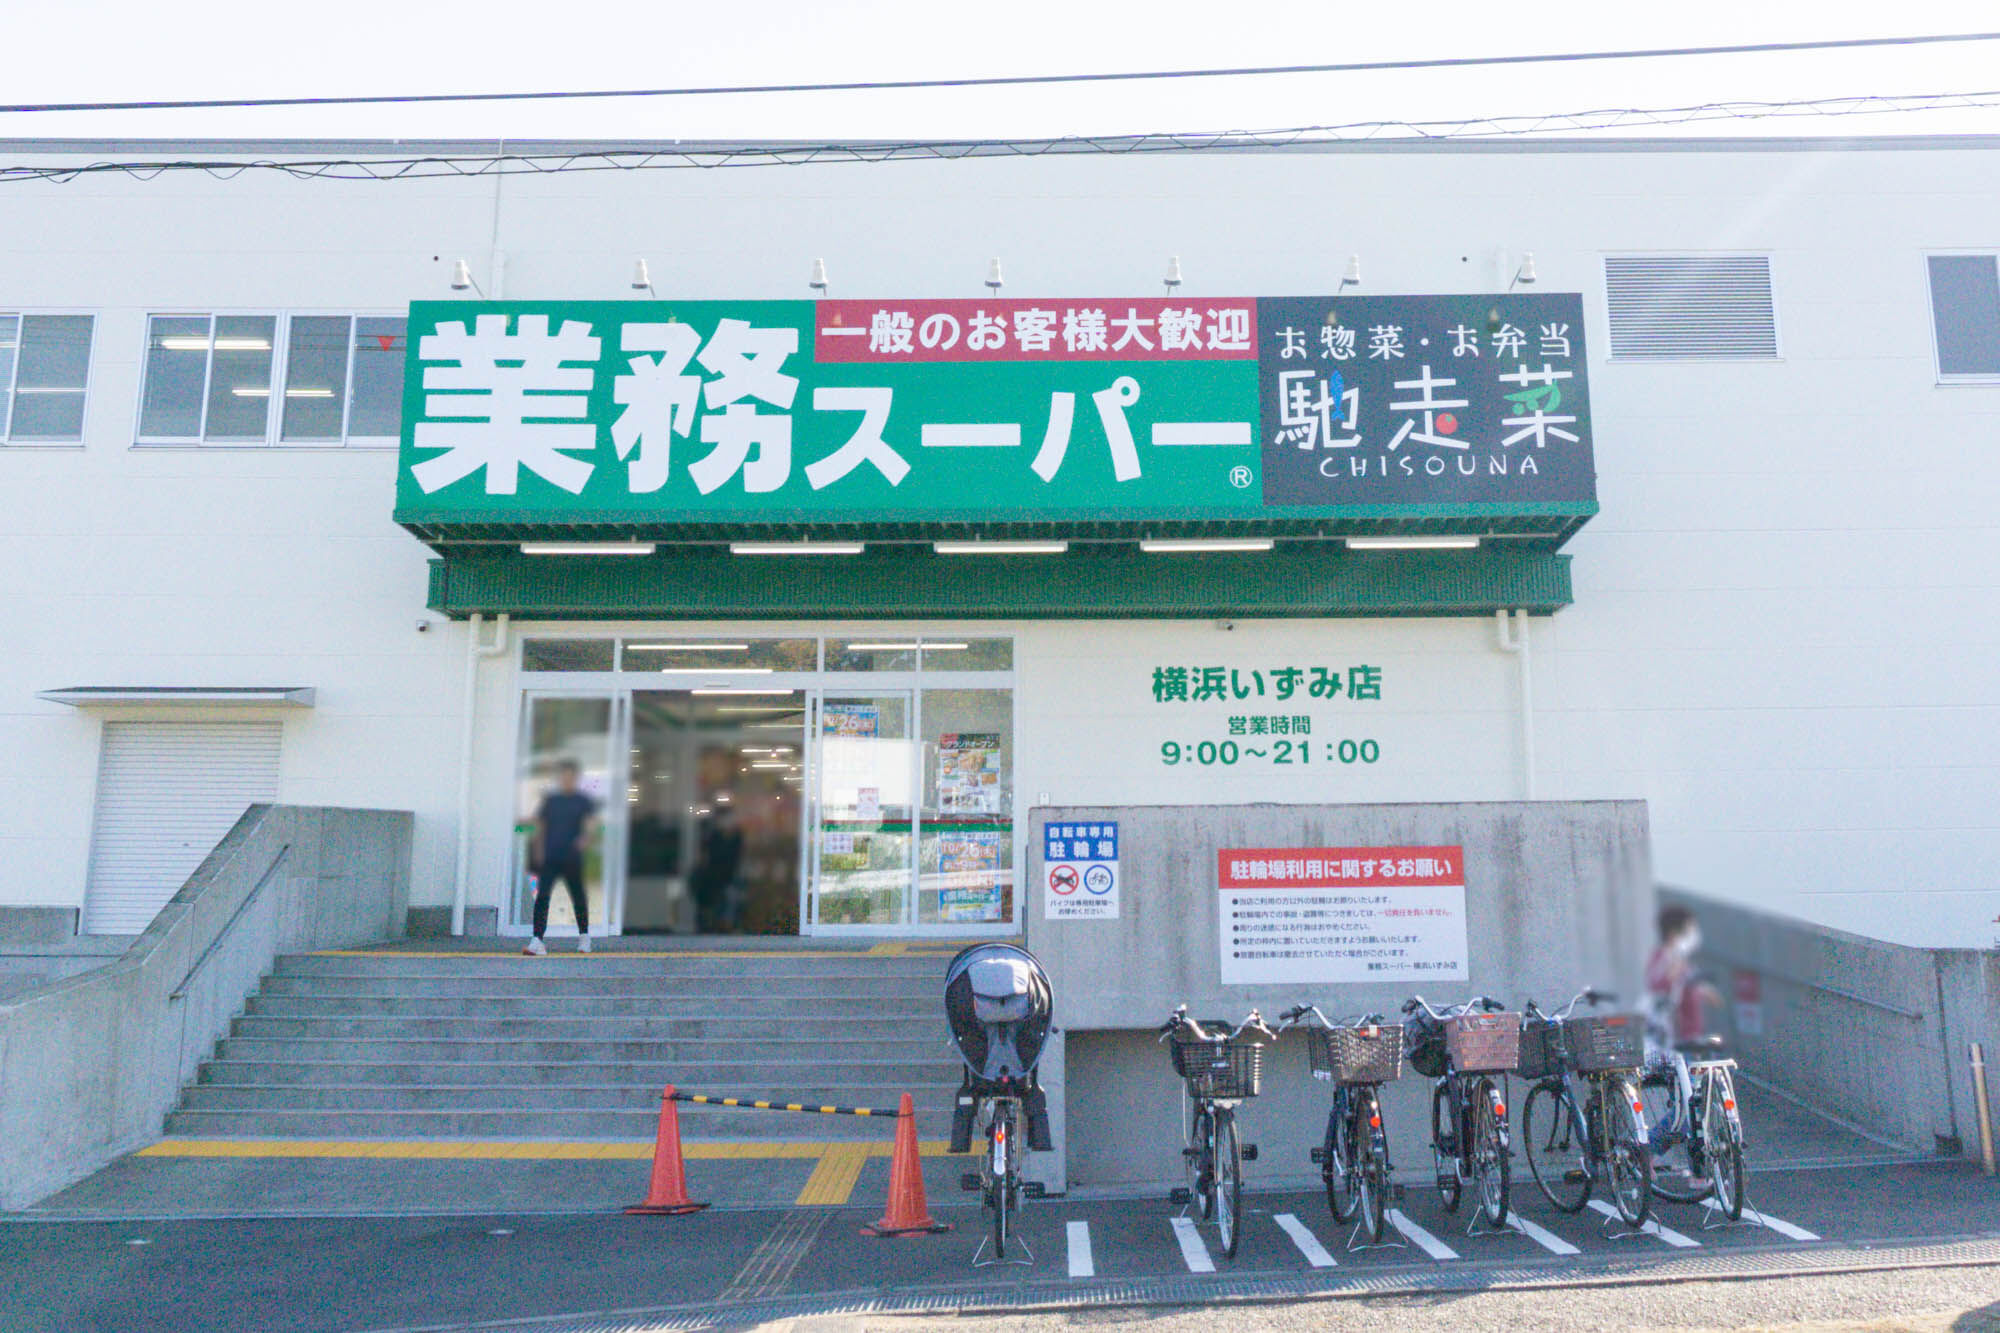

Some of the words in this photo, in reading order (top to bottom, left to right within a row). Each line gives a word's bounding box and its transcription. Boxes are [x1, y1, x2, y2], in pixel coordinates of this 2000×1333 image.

[821, 308, 1251, 354] 一般のお客様大歓迎
[1274, 321, 1571, 361] お惣菜・お弁当
[410, 314, 1252, 495] 業務スーパー
[1274, 363, 1580, 452] 馳走菜
[1319, 454, 1540, 478] CHISOUNA
[1152, 664, 1382, 703] 横浜いずみ店
[1228, 715, 1311, 736] 営業時間
[1049, 841, 1113, 858] 駐輪場
[1231, 859, 1452, 880] 駐輪場利用に関するお願い
